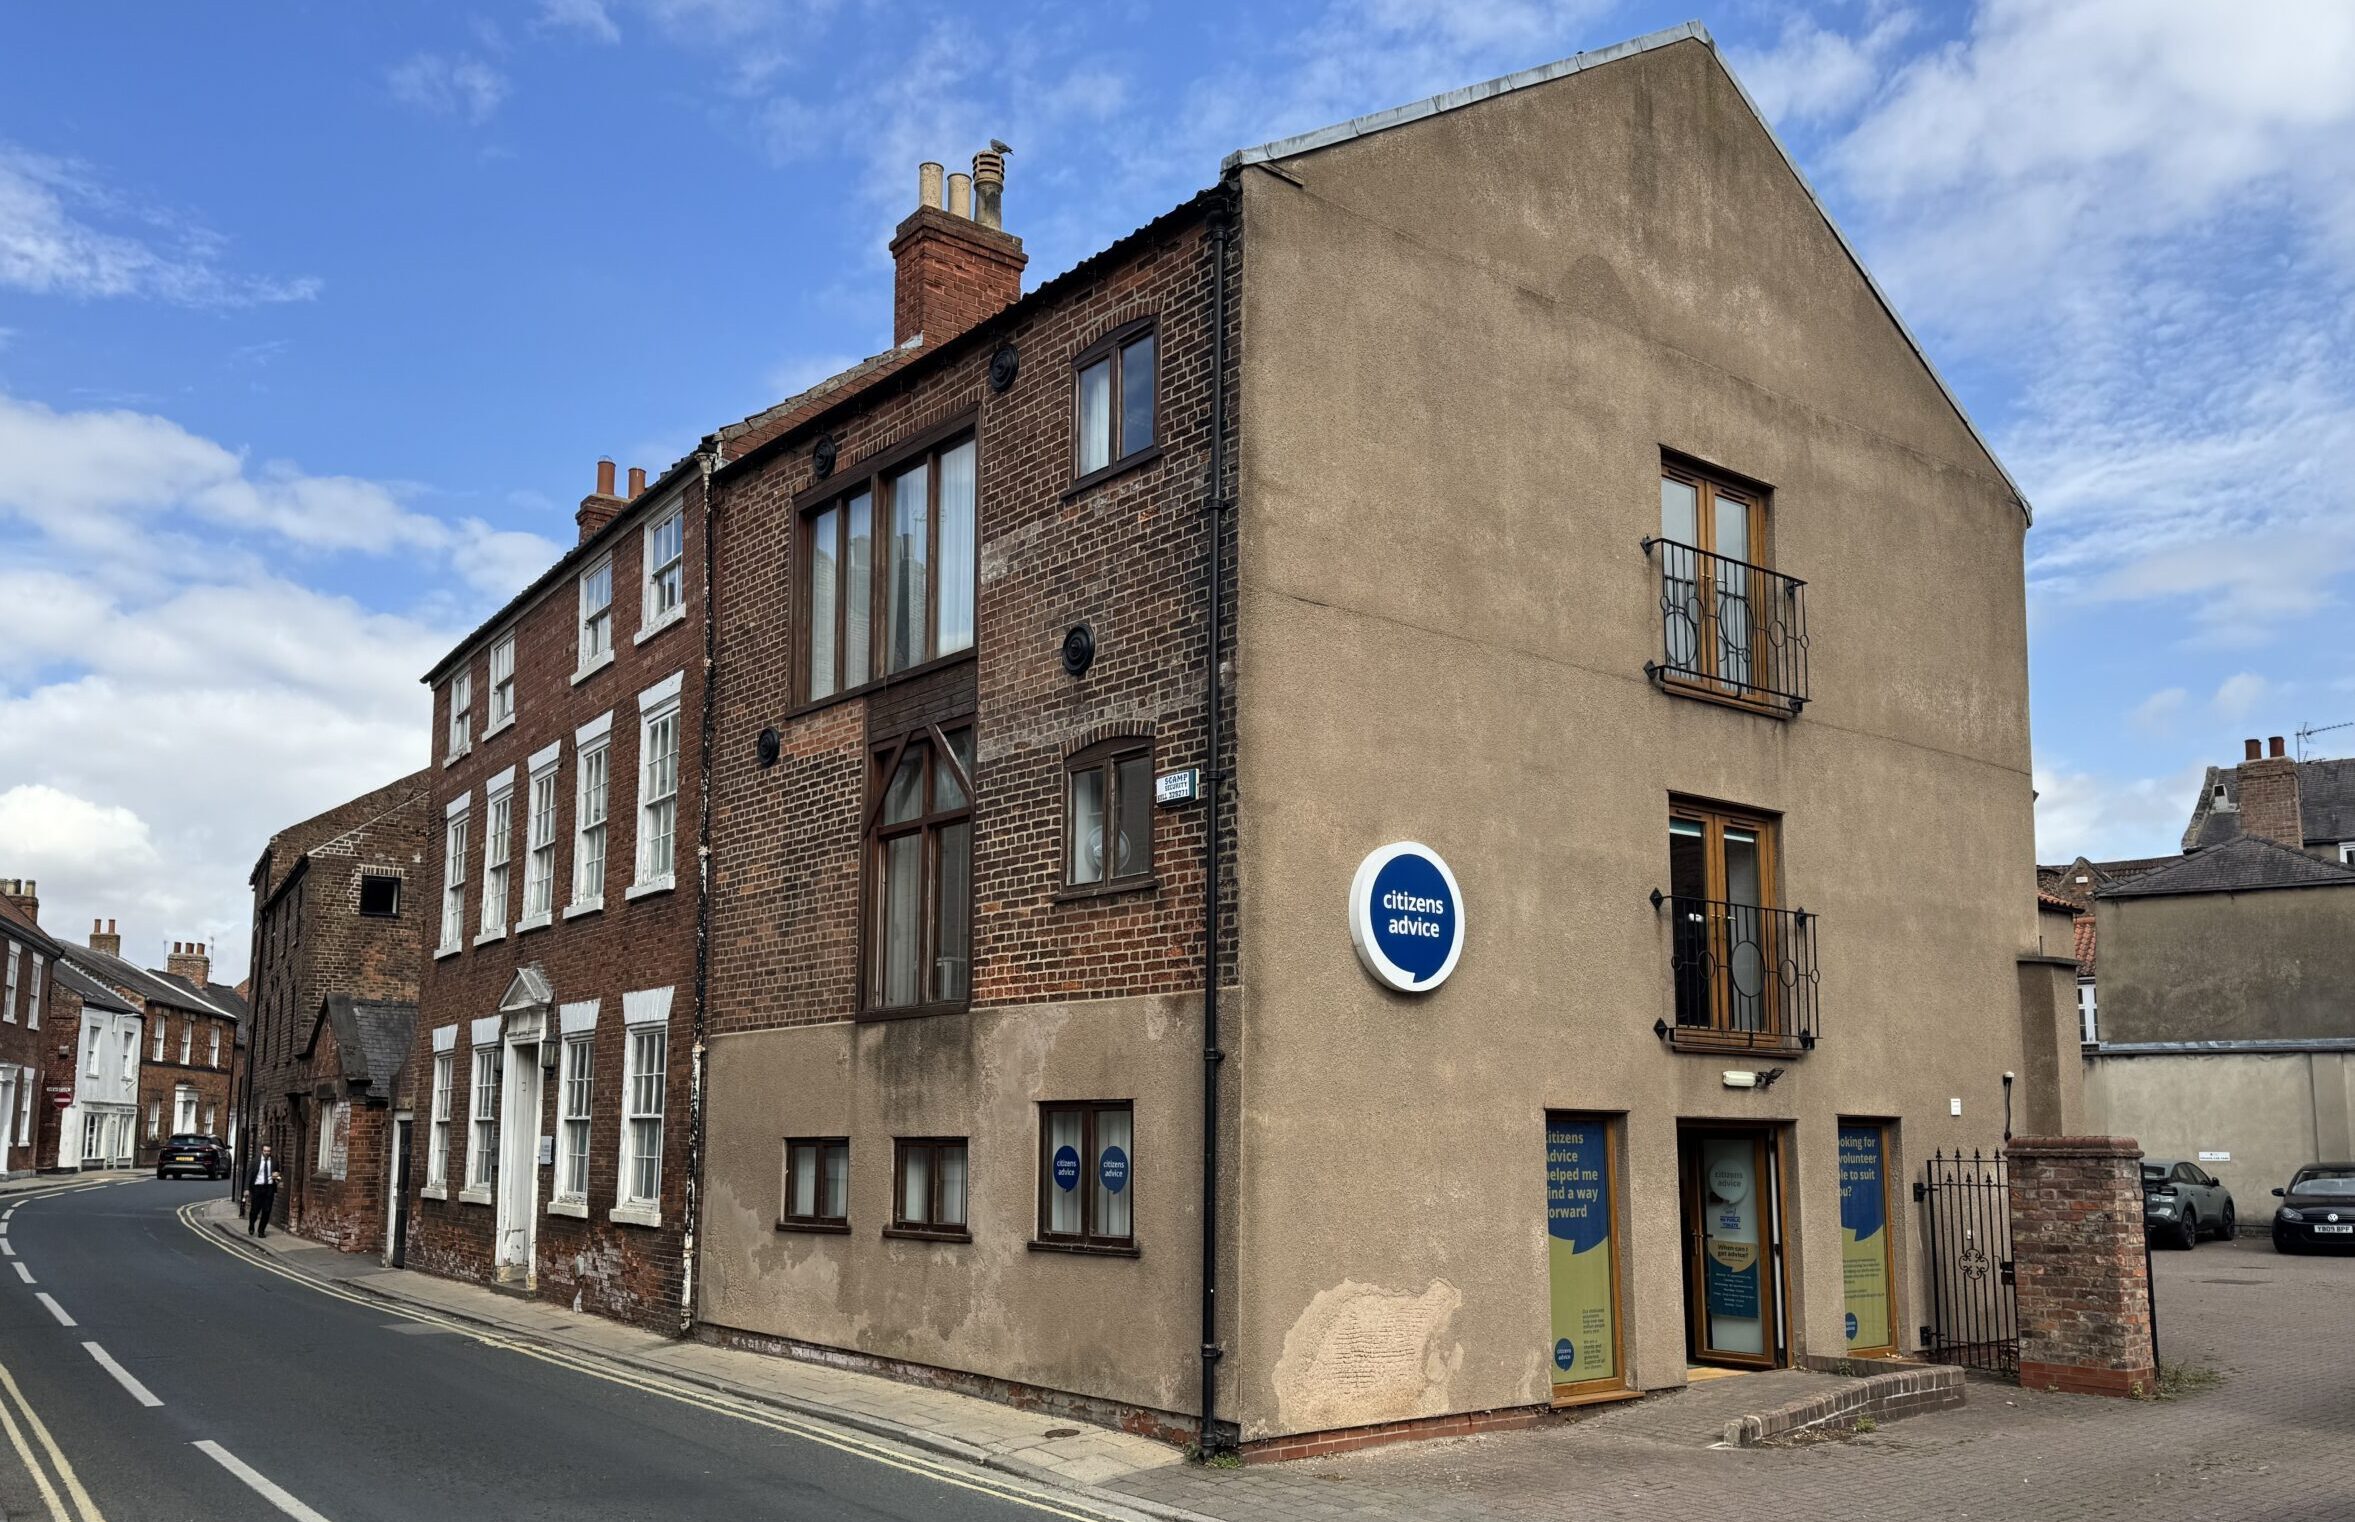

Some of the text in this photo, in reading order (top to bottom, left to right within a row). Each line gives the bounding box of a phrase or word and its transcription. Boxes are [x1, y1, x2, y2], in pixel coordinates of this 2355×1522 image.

[1165, 773, 1188, 785] SCAMP
[1165, 782, 1187, 791] SECURITY
[1383, 889, 1444, 915] citizens
[1388, 915, 1440, 938] advice
[1839, 1136, 1876, 1150] oking for
[1056, 1159, 1077, 1167] citizens
[1104, 1161, 1124, 1169] citizens
[1058, 1167, 1075, 1176] advice
[1105, 1169, 1123, 1178] advice
[1581, 1170, 1598, 1181] me
[1714, 1171, 1744, 1179] citizens
[1849, 1170, 1859, 1180] to
[1859, 1168, 1876, 1180] suit
[1717, 1179, 1742, 1188] advice
[1547, 1186, 1599, 1203] ind a way
[1547, 1204, 1587, 1218] orward
